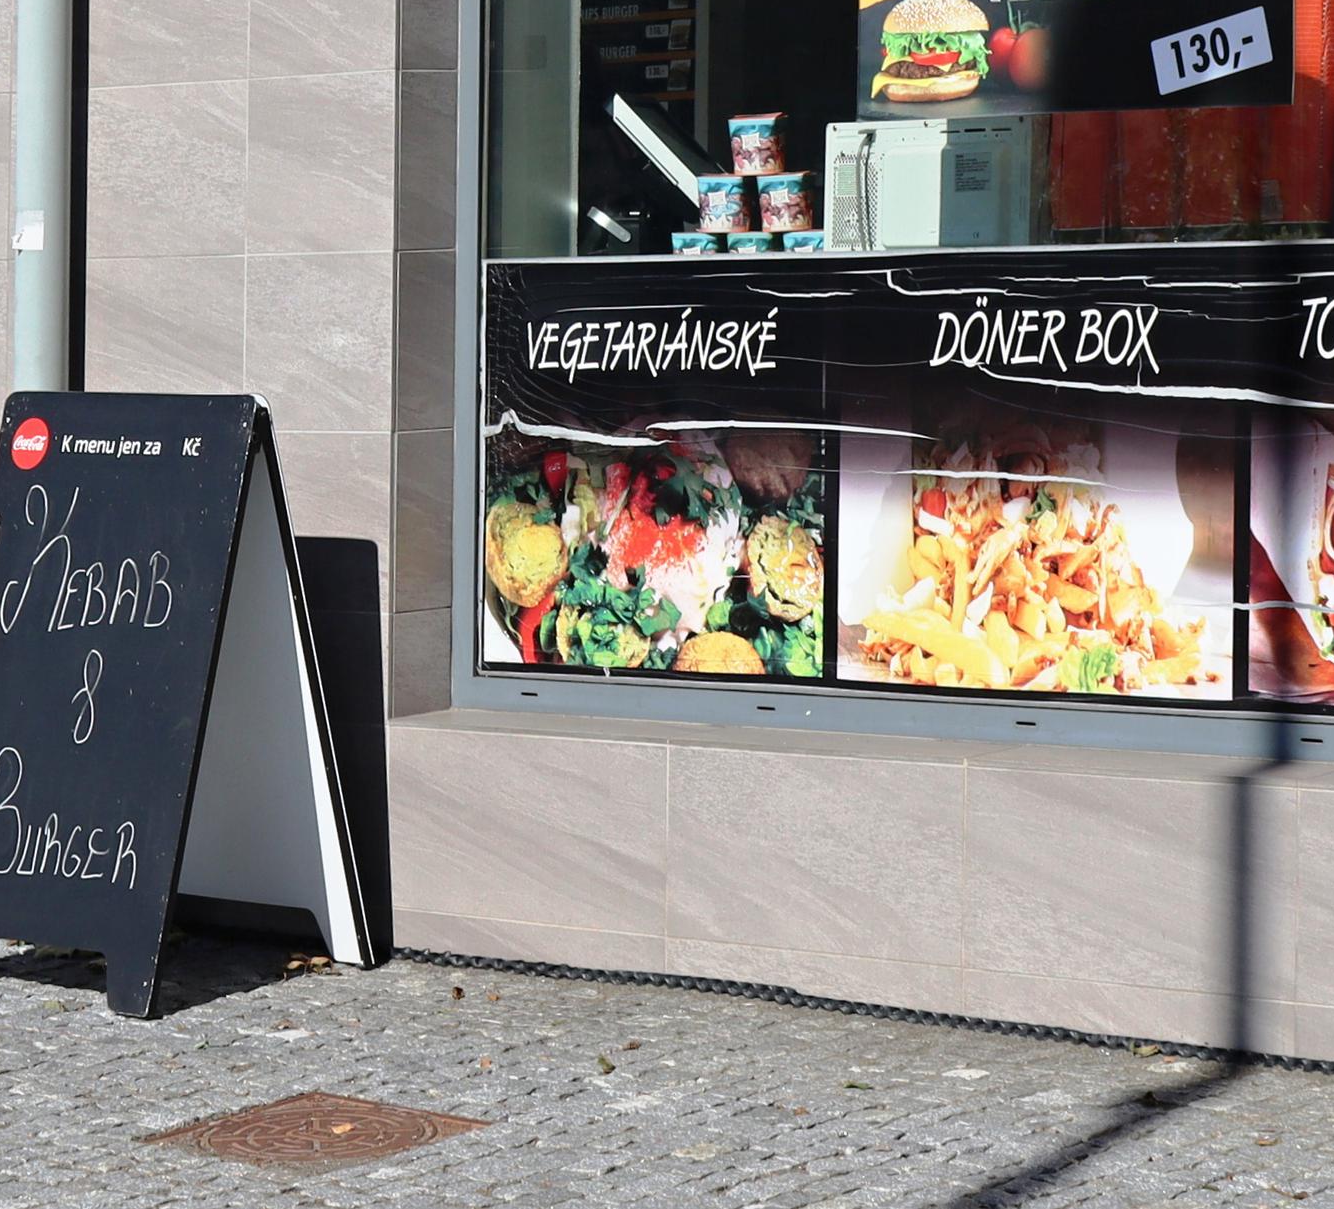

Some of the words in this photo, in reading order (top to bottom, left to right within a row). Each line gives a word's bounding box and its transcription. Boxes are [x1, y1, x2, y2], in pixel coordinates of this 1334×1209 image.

[1170, 26, 1254, 79] 130,-
[526, 307, 779, 383] VEGETARIÁNSKÉ
[929, 296, 1068, 373] DÖNER
[1075, 304, 1160, 374] BOX
[61, 434, 73, 453] K
[74, 439, 115, 455] menu
[117, 436, 141, 459] jen
[143, 441, 162, 456] za
[182, 437, 202, 457] Kč
[0, 484, 174, 634] KEBAB
